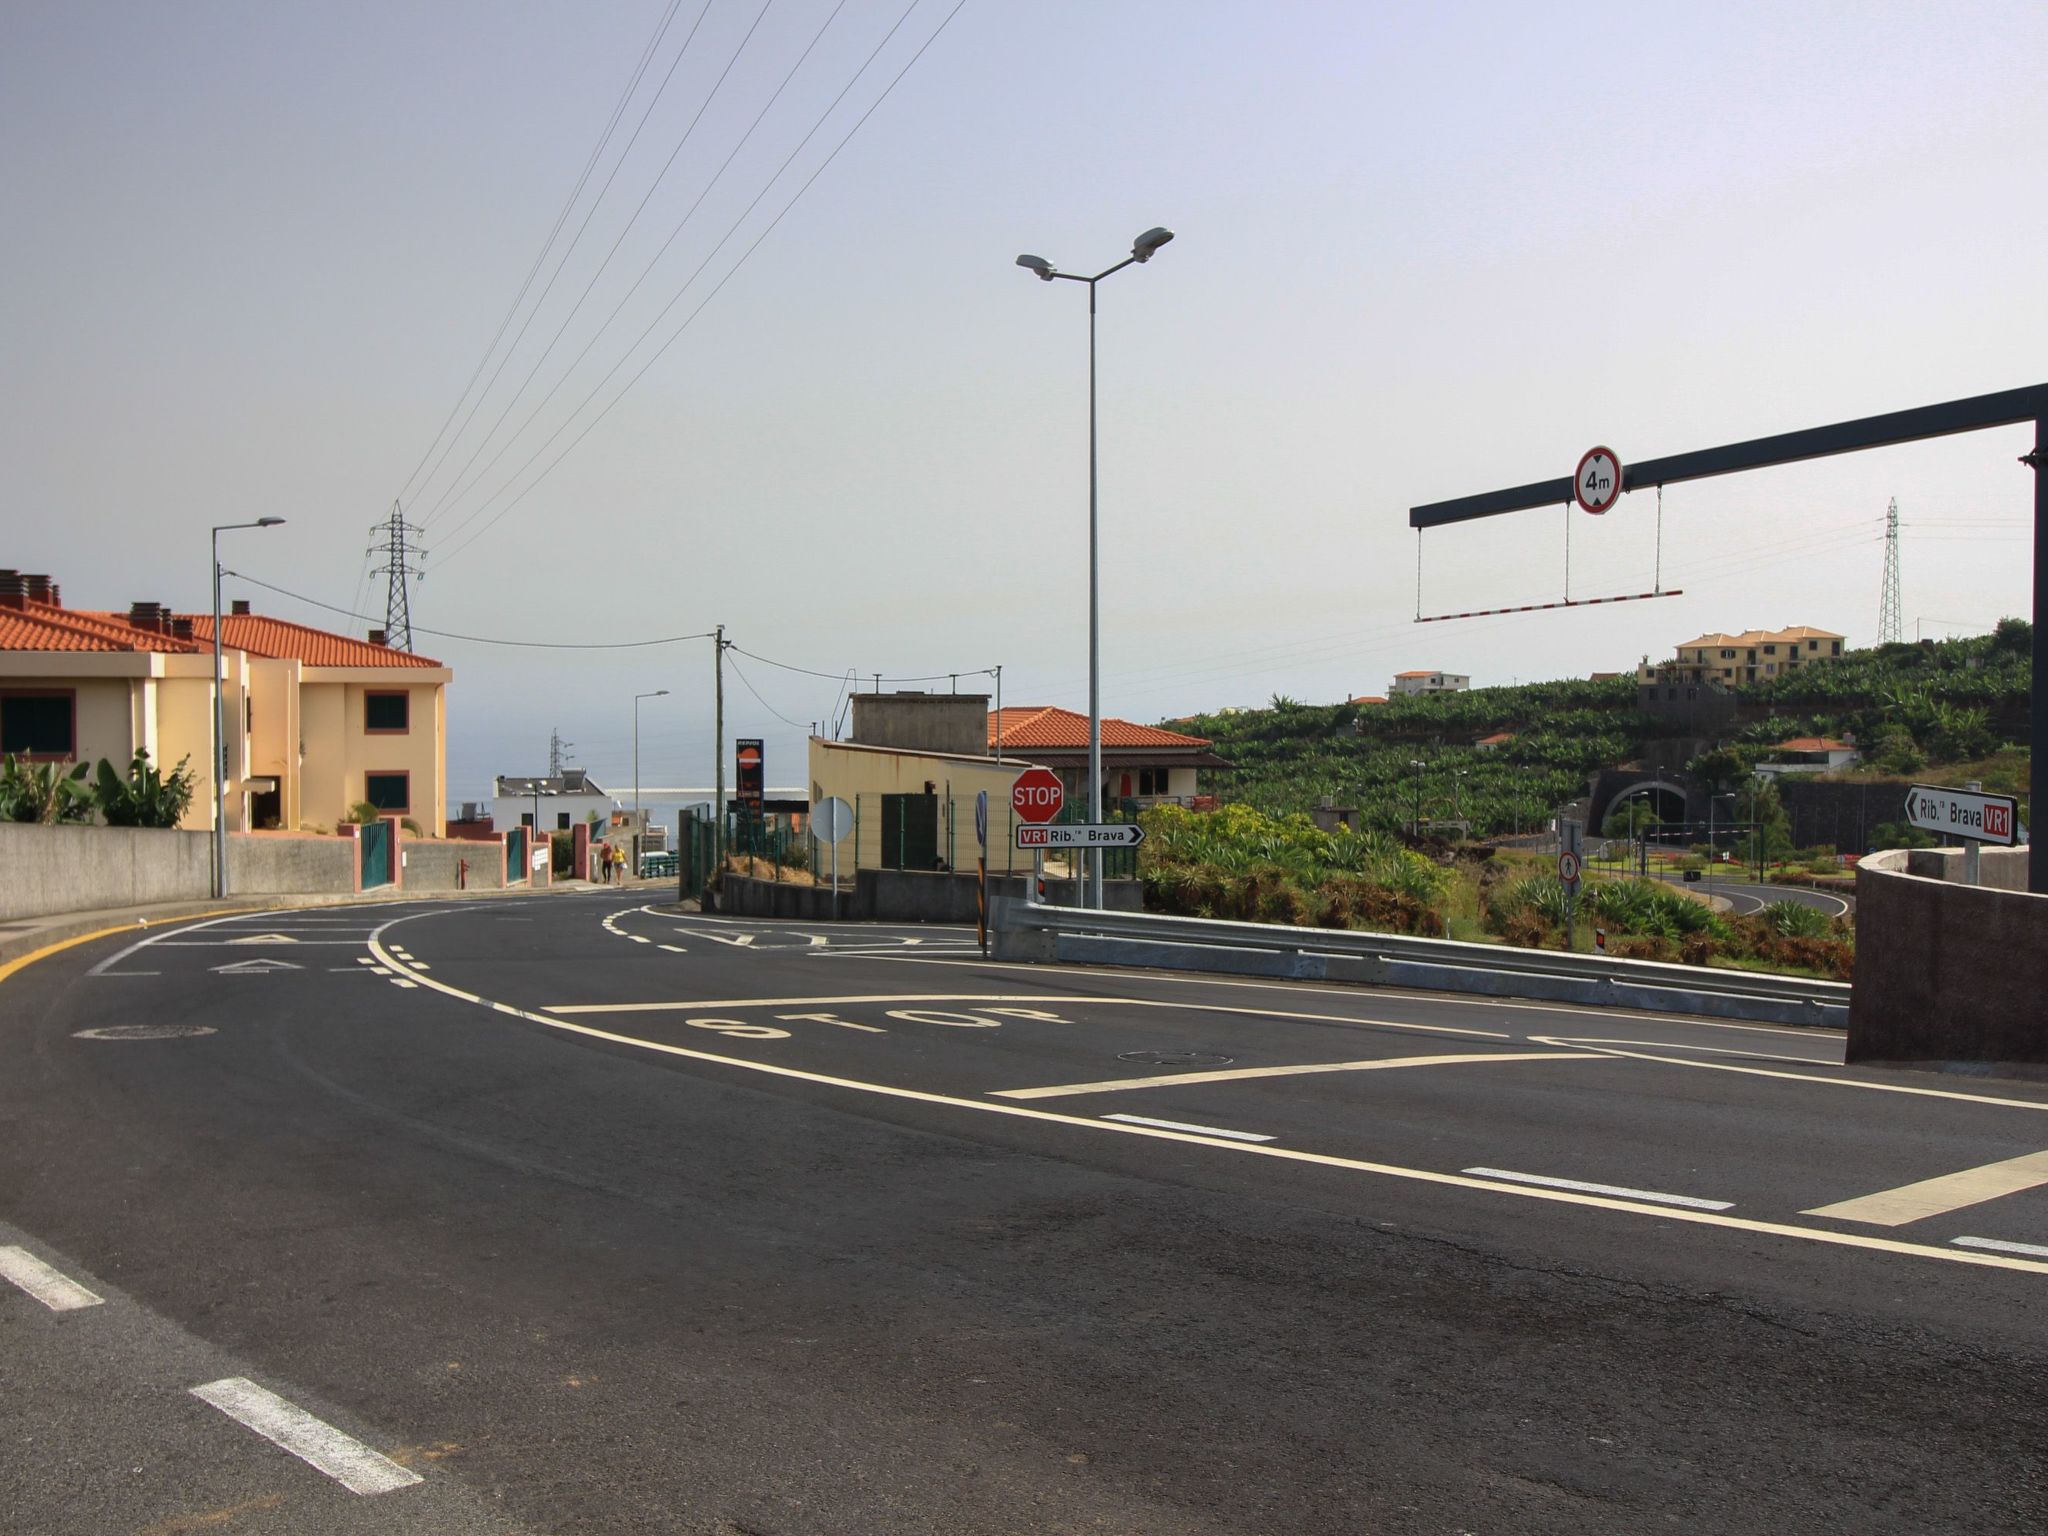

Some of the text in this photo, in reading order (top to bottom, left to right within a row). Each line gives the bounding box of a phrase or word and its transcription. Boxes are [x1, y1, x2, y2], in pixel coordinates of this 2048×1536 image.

[1014, 786, 1061, 806] STOP
[1950, 802, 1982, 828] Brava
[1985, 806, 2008, 835] VR1
[1022, 830, 1047, 843] VR1
[1088, 830, 1124, 841] Brava
[685, 1008, 1076, 1039] STOP
